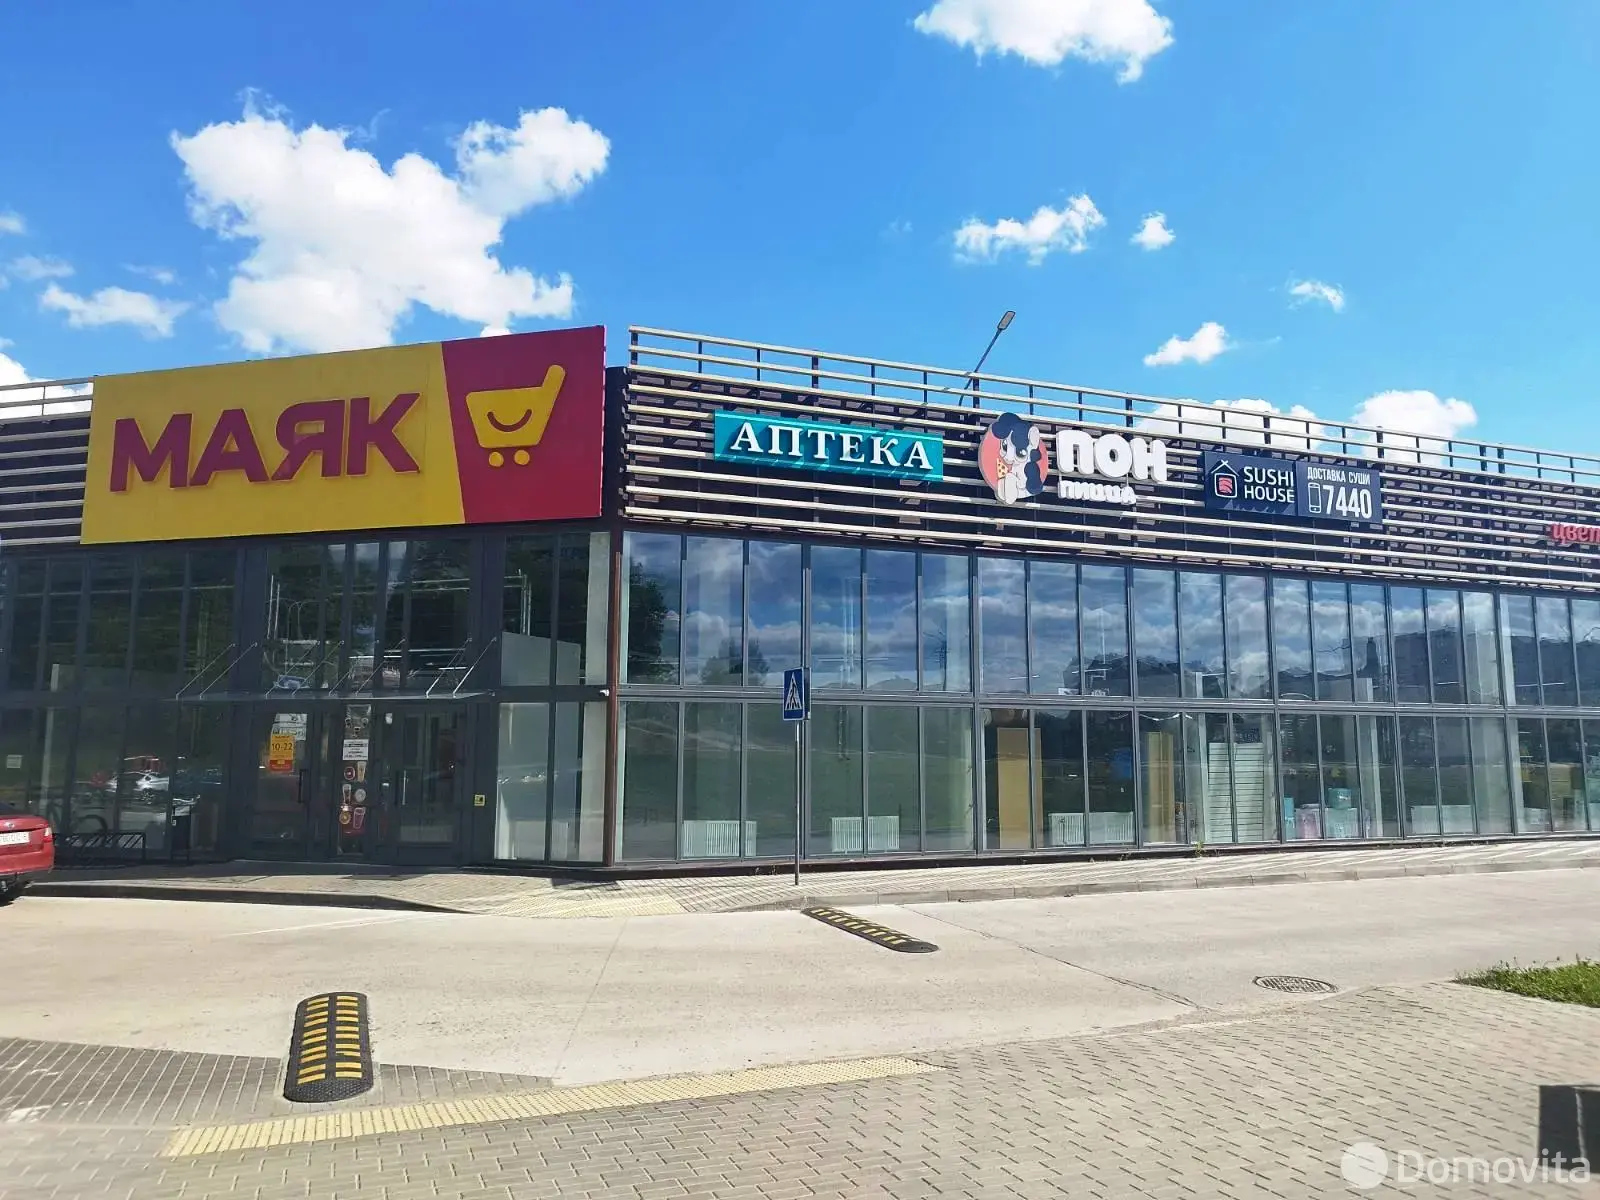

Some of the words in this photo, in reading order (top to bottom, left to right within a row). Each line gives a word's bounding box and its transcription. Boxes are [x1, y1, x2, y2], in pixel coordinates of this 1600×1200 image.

[109, 392, 422, 493] МАЯК
[730, 421, 934, 471] АПТЕКА
[1056, 428, 1168, 483] ПОН
[1243, 466, 1294, 486] SUSHI
[1307, 466, 1346, 483] ДОСТАВКА
[1348, 471, 1371, 486] СУШИ
[1243, 484, 1296, 504] HOUSE
[1322, 484, 1373, 519] 7440
[271, 742, 293, 751] 10-22
